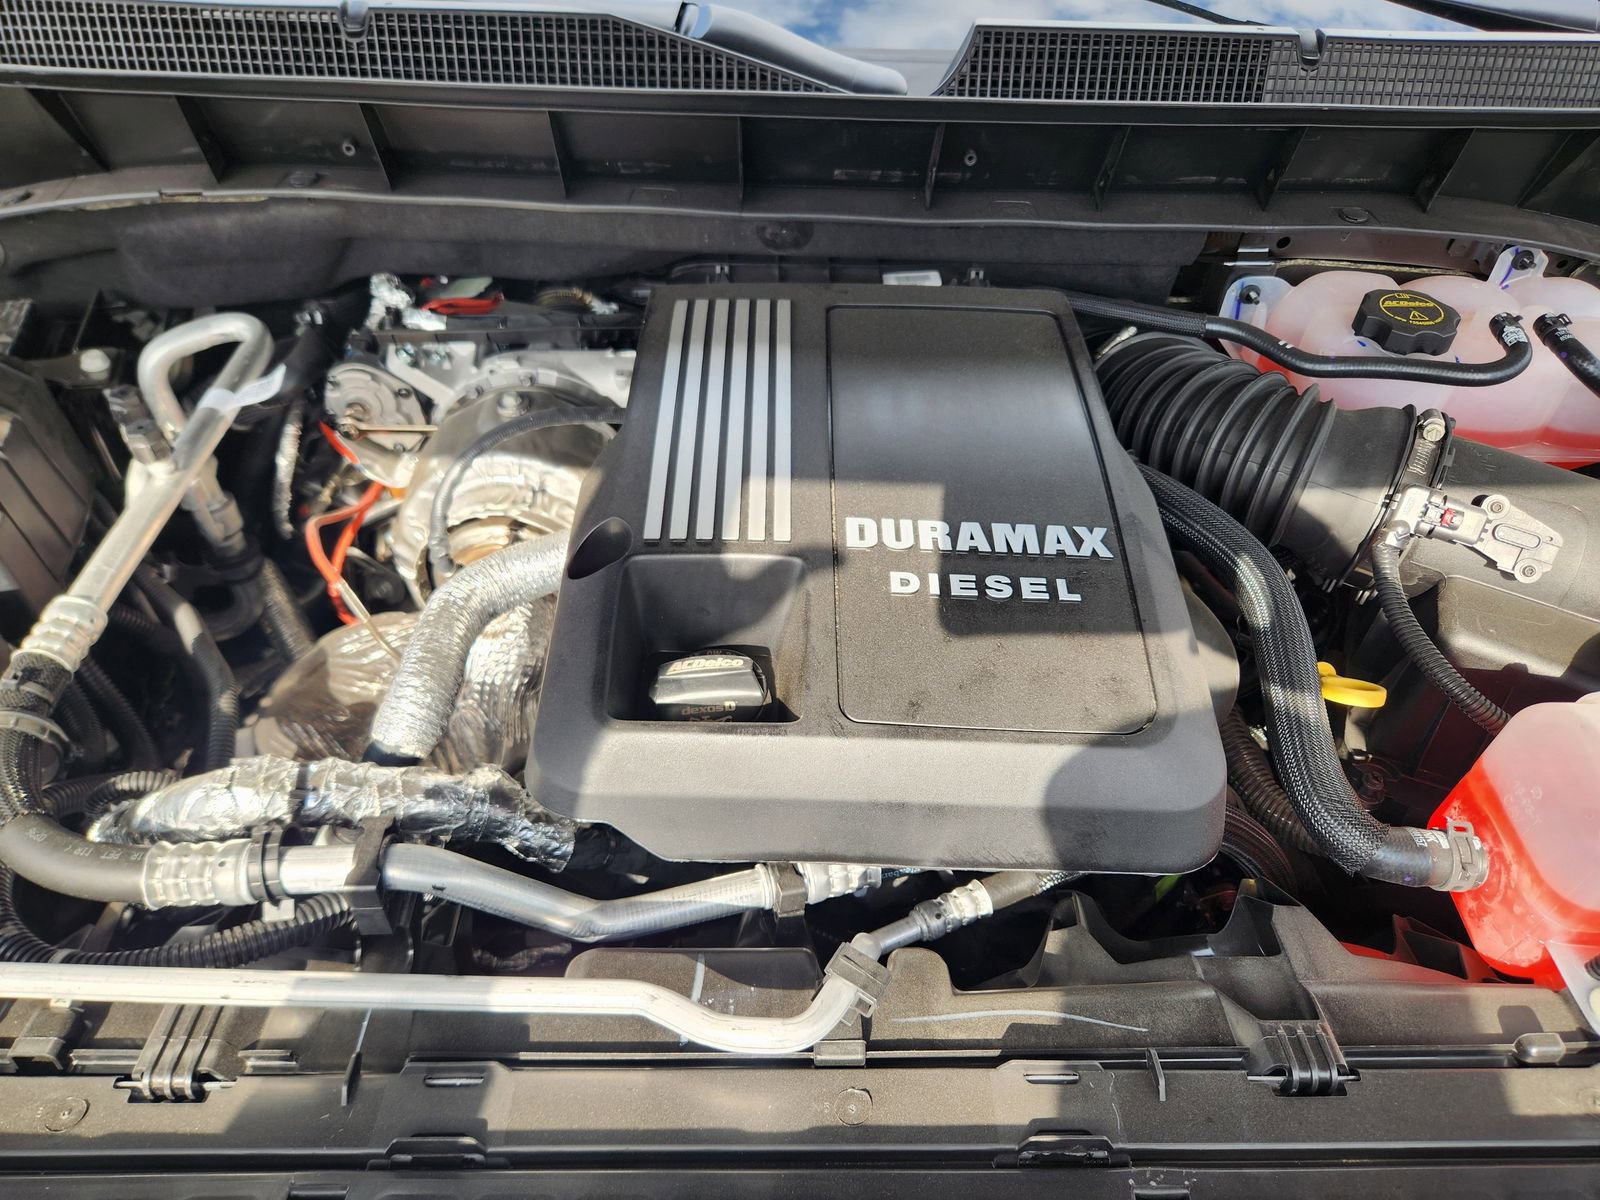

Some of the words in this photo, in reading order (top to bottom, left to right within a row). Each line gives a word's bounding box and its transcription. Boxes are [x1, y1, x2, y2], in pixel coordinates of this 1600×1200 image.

[845, 516, 1114, 558] DURAMAX
[889, 571, 1082, 601] DIESEL
[669, 657, 743, 672] ACDelco
